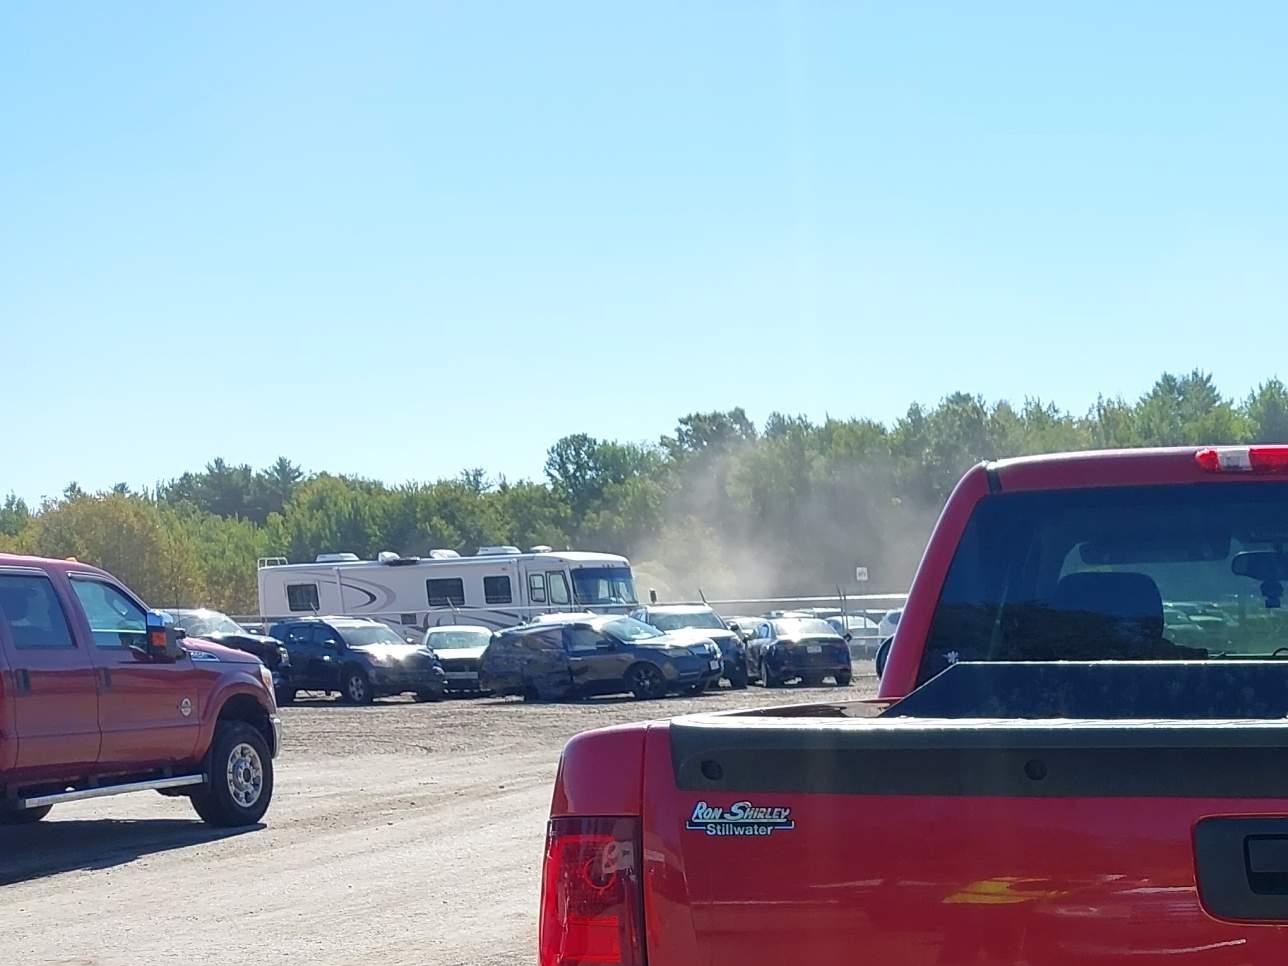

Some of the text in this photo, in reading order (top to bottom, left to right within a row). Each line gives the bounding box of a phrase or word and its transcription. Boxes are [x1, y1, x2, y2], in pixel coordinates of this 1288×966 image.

[692, 801, 790, 820] RON SHIRLEY
[706, 823, 774, 836] Stillwater
